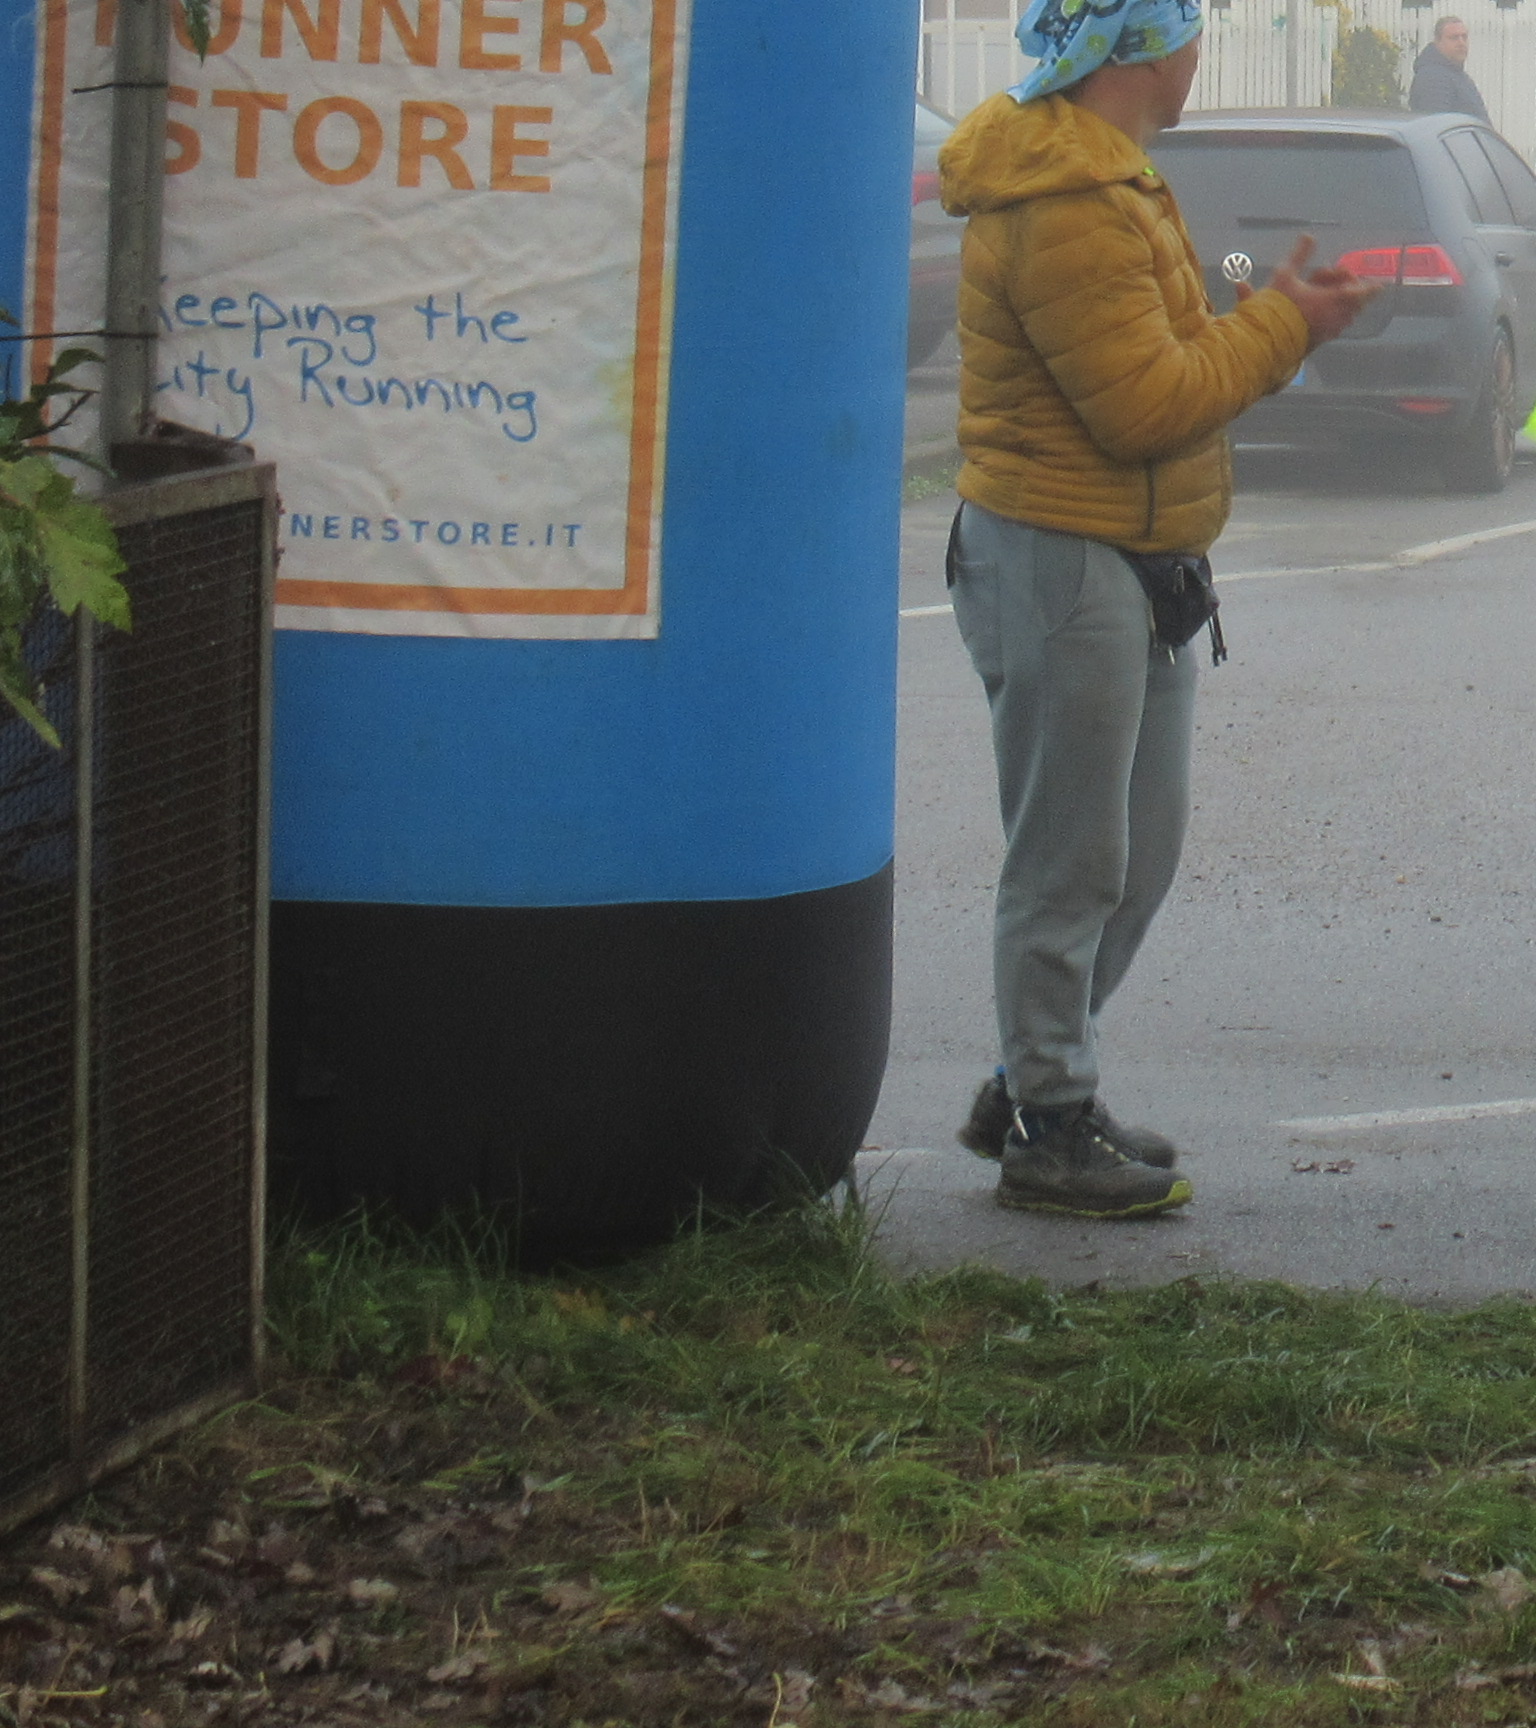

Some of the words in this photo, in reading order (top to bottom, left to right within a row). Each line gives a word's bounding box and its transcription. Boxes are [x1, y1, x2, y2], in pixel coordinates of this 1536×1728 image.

[157, 275, 376, 366] eeping
[415, 292, 528, 343] the
[154, 349, 255, 441] ity
[287, 336, 538, 443] Running
[280, 511, 583, 548] NERSTORE.IT
